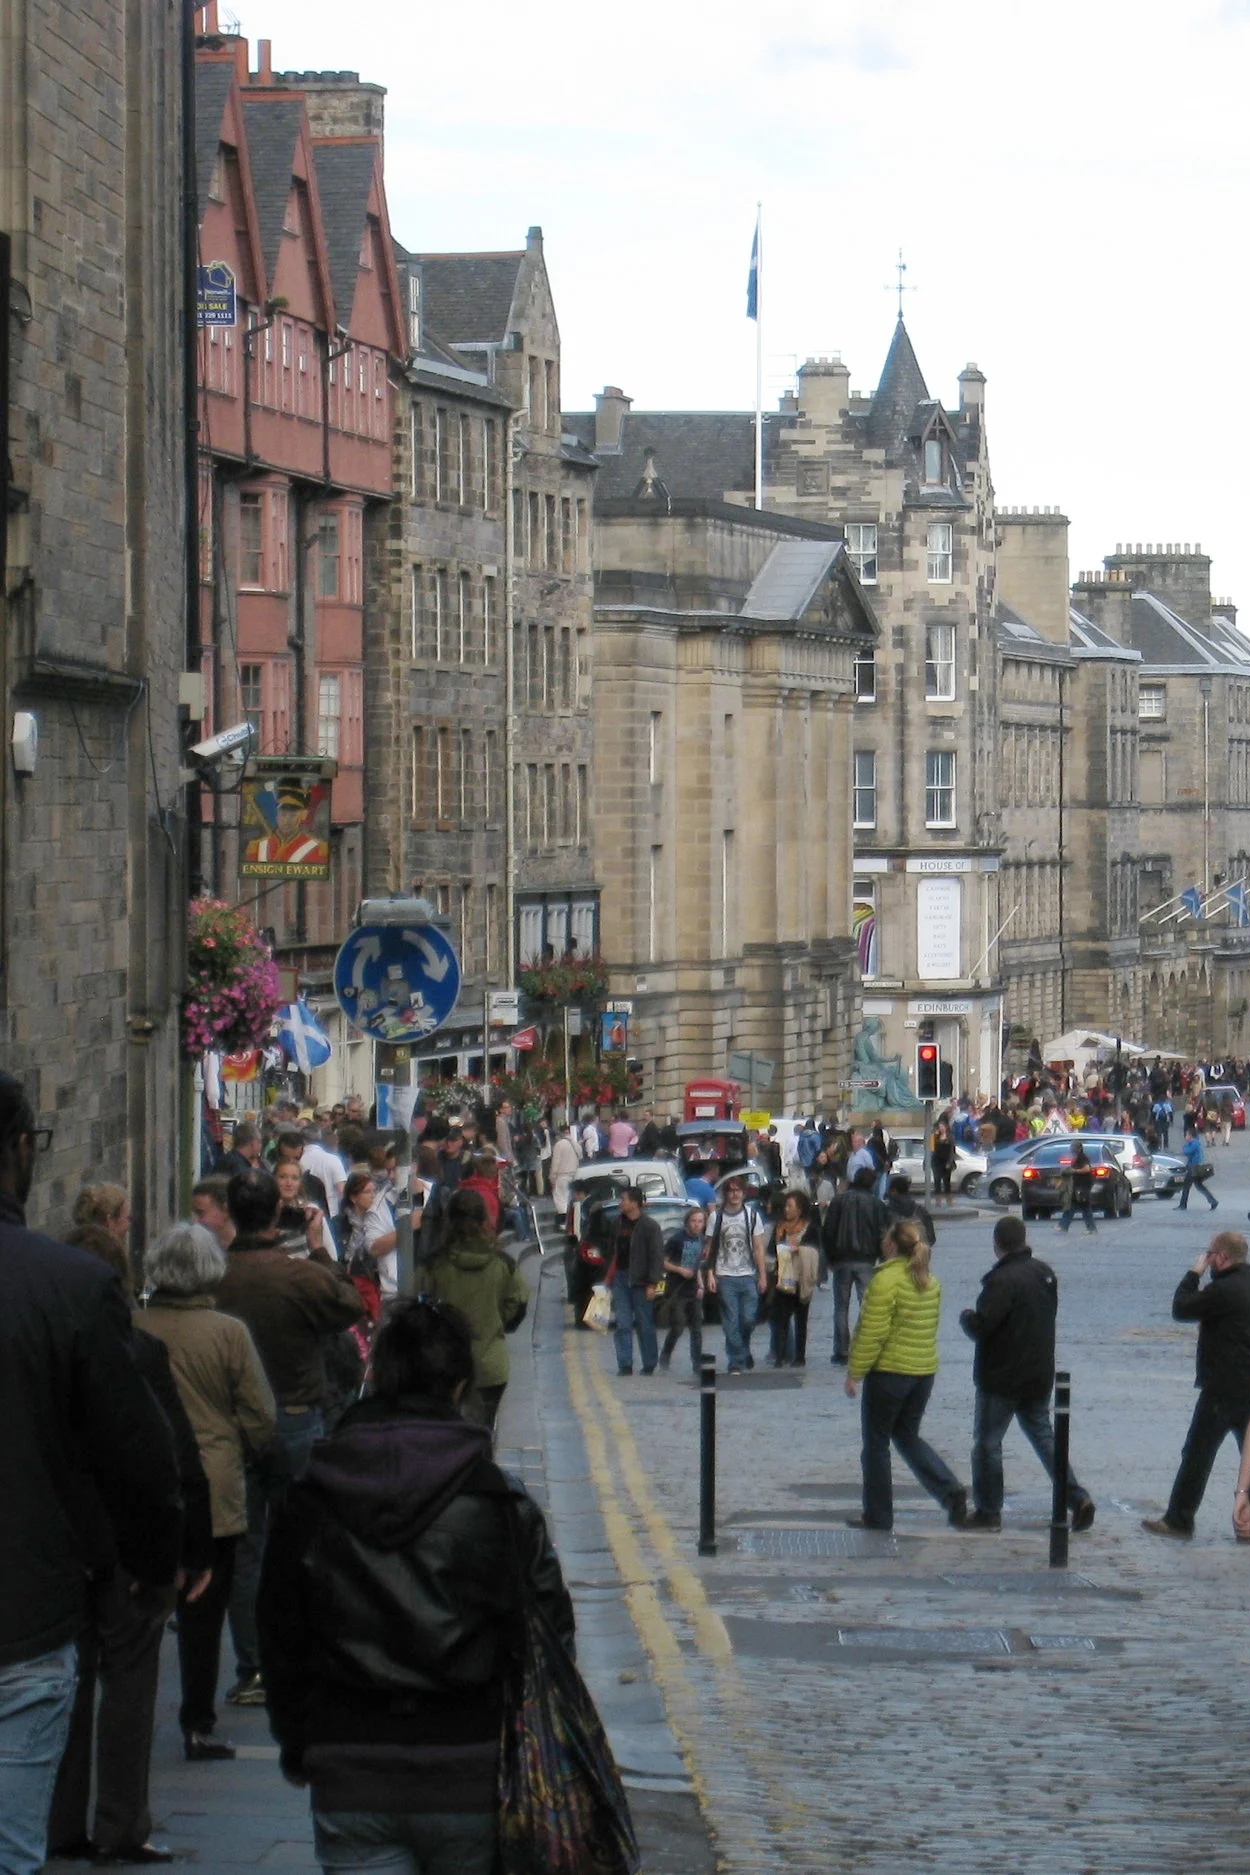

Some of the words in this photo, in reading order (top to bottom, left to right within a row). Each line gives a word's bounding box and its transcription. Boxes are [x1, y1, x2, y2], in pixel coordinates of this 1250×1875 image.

[243, 864, 284, 875] ENSIGN
[286, 865, 326, 876] EWART
[920, 861, 953, 870] HOUSE
[917, 1003, 969, 1013] EDINBURGH
